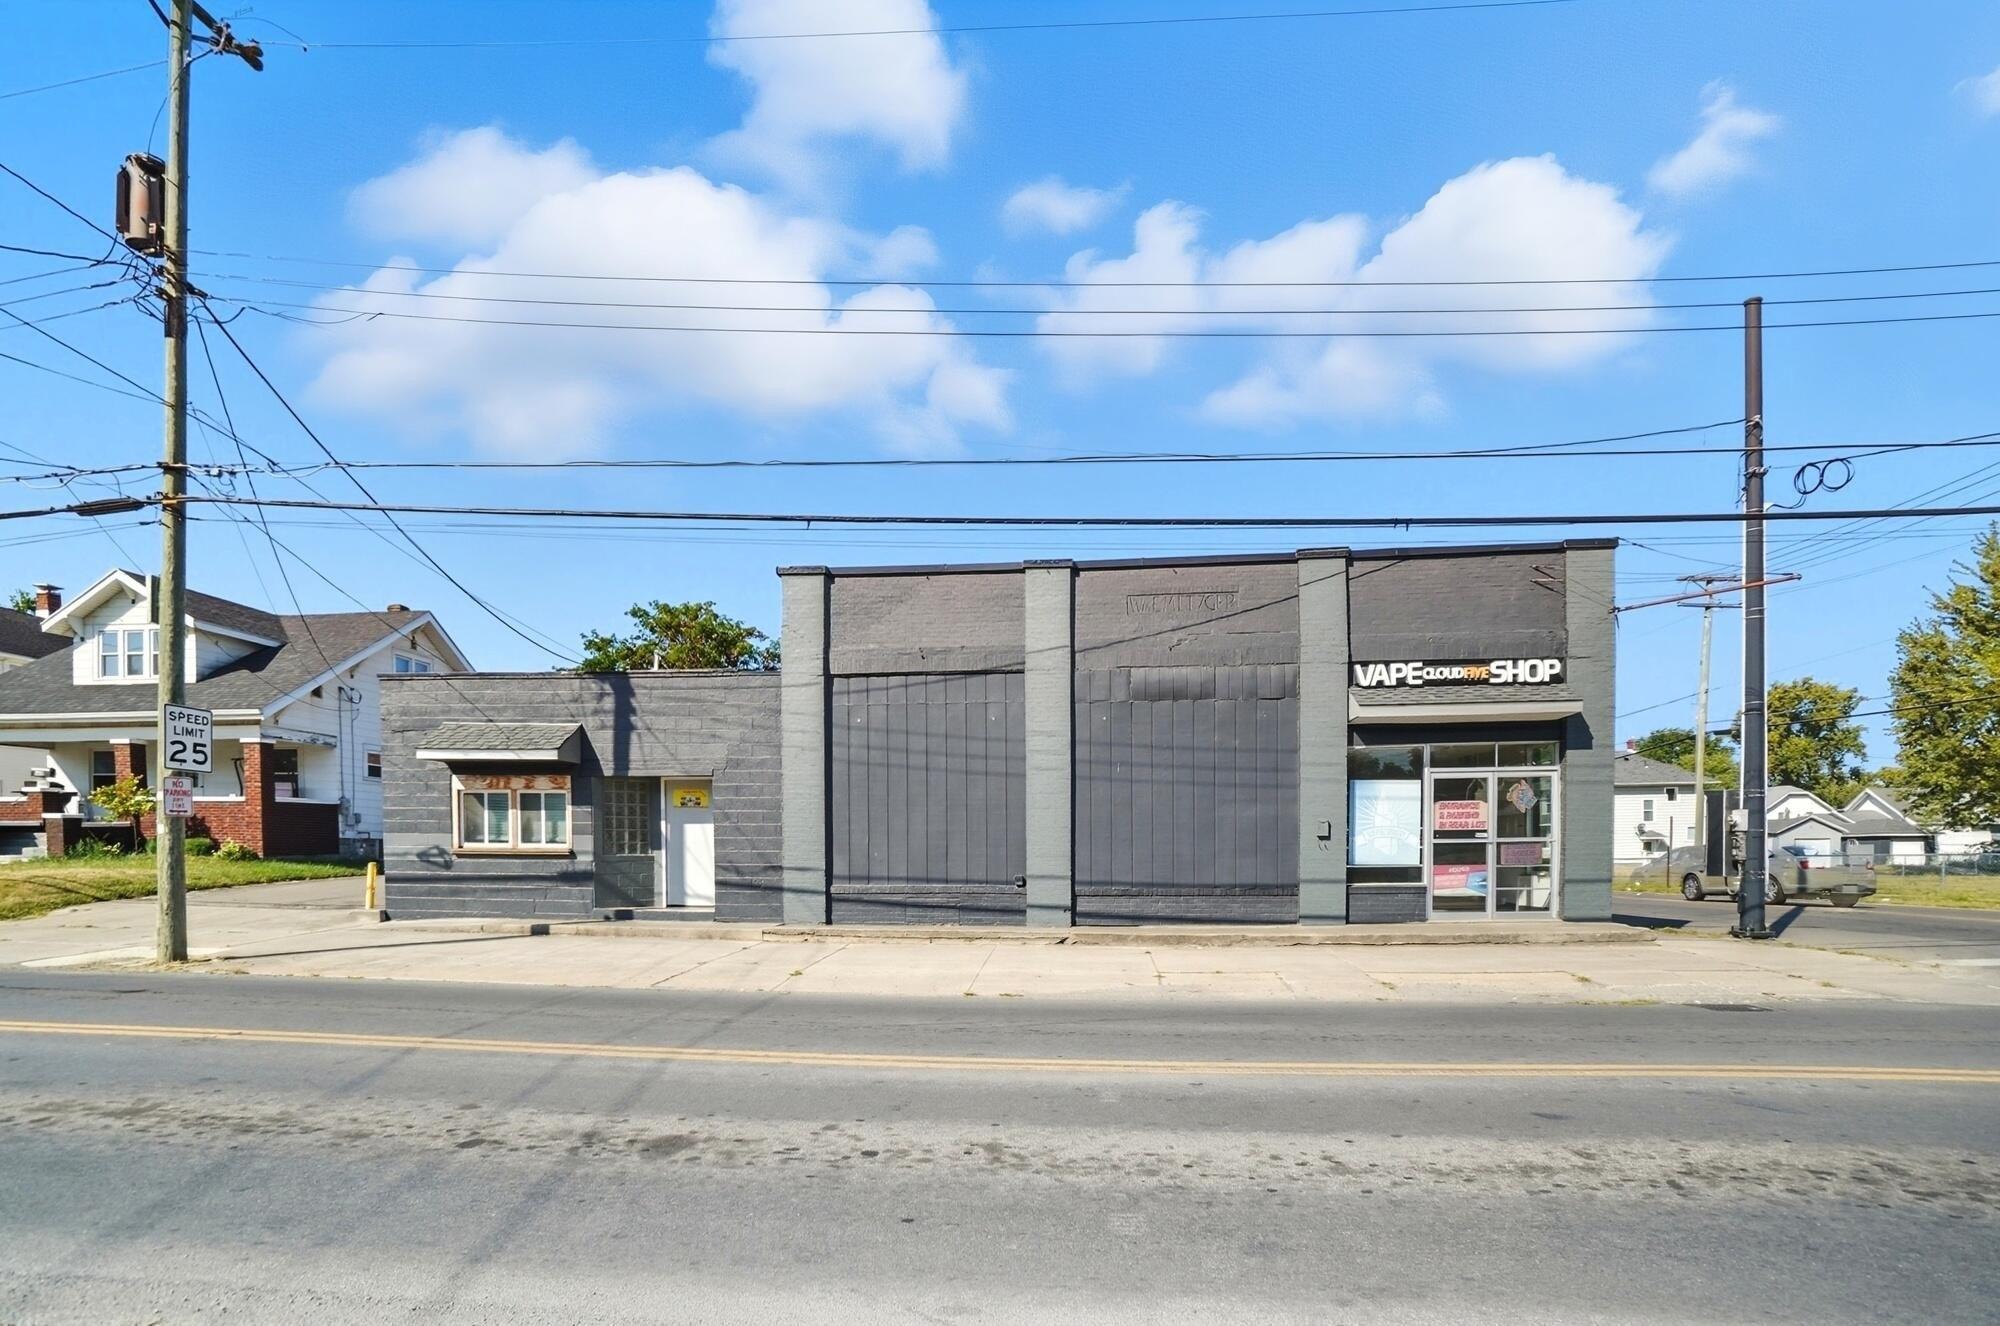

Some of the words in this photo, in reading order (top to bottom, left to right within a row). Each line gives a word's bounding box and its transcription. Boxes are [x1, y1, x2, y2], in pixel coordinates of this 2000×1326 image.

[1355, 662, 1423, 686] VAPE
[1489, 659, 1561, 683] SHOP
[169, 711, 209, 726] SPEED
[173, 725, 205, 738] LIMIT
[169, 740, 208, 765] 25
[172, 780, 184, 788] NO
